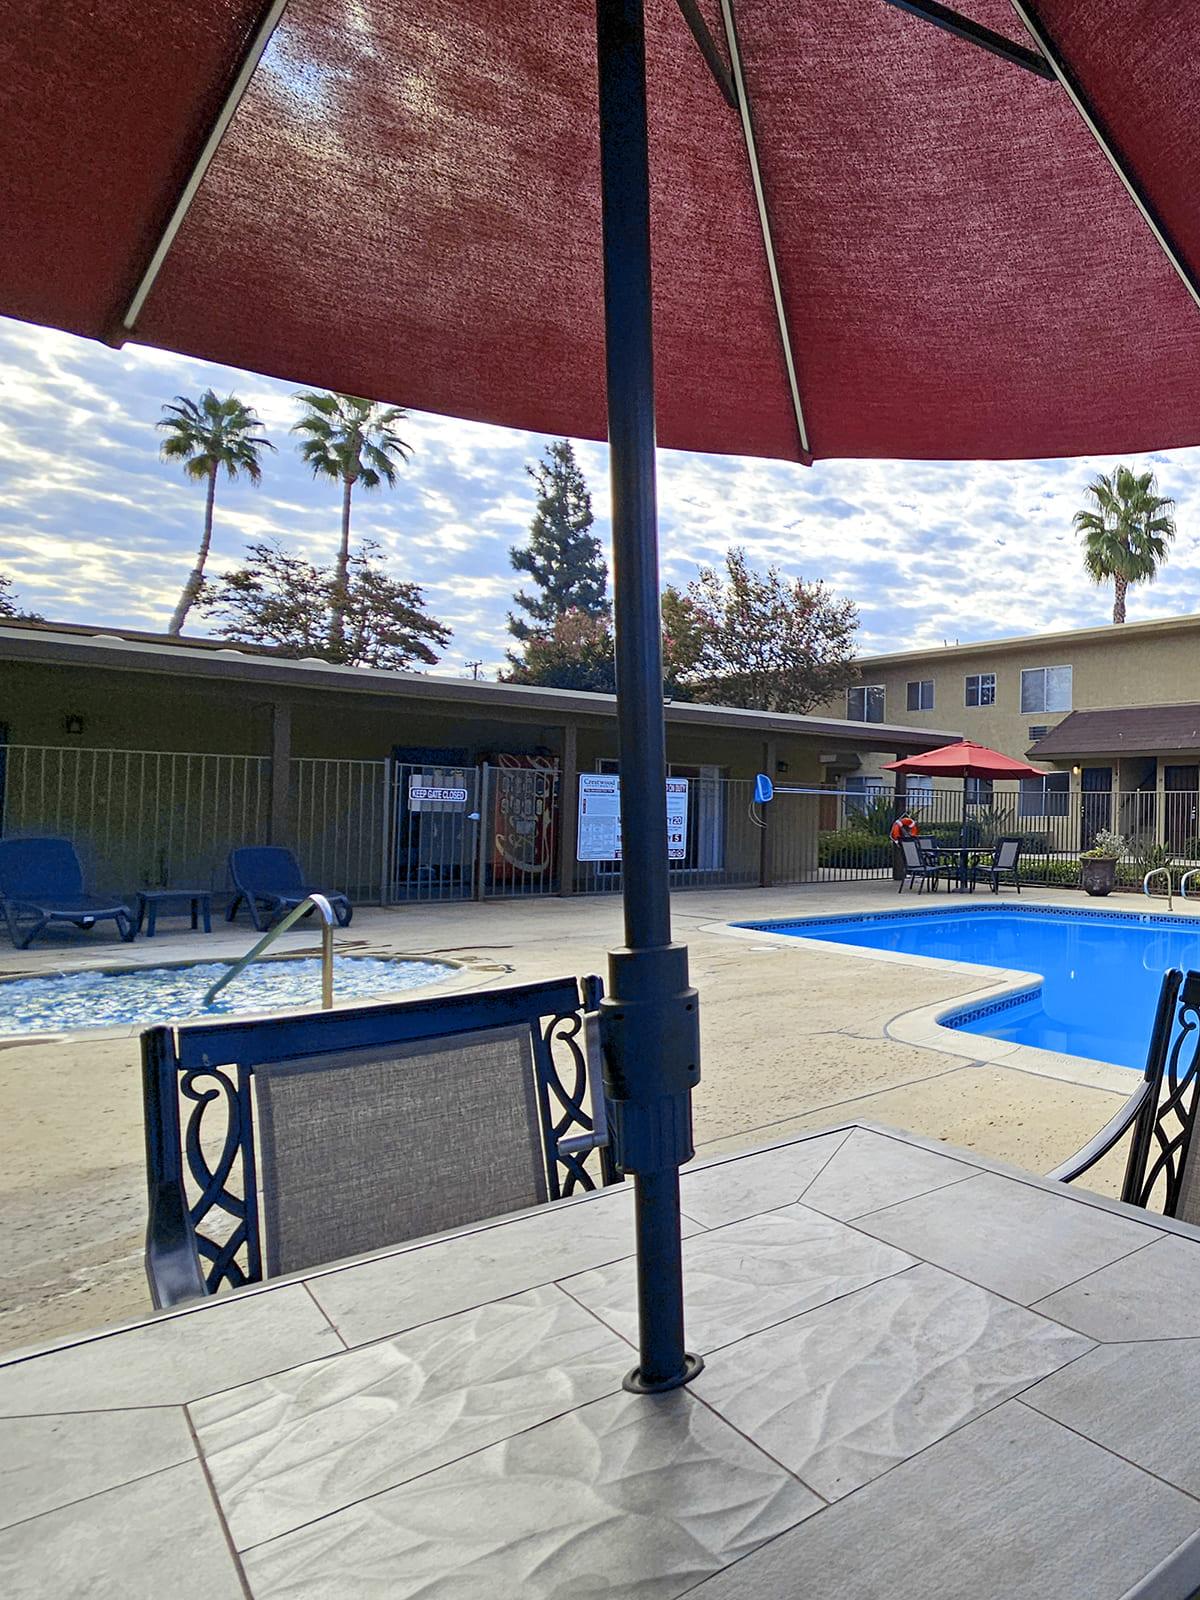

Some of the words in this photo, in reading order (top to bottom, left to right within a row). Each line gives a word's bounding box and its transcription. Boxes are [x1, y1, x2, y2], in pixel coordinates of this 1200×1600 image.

[412, 790, 426, 798] KEEP
[428, 790, 442, 798] GATE
[443, 791, 464, 800] CLOSED
